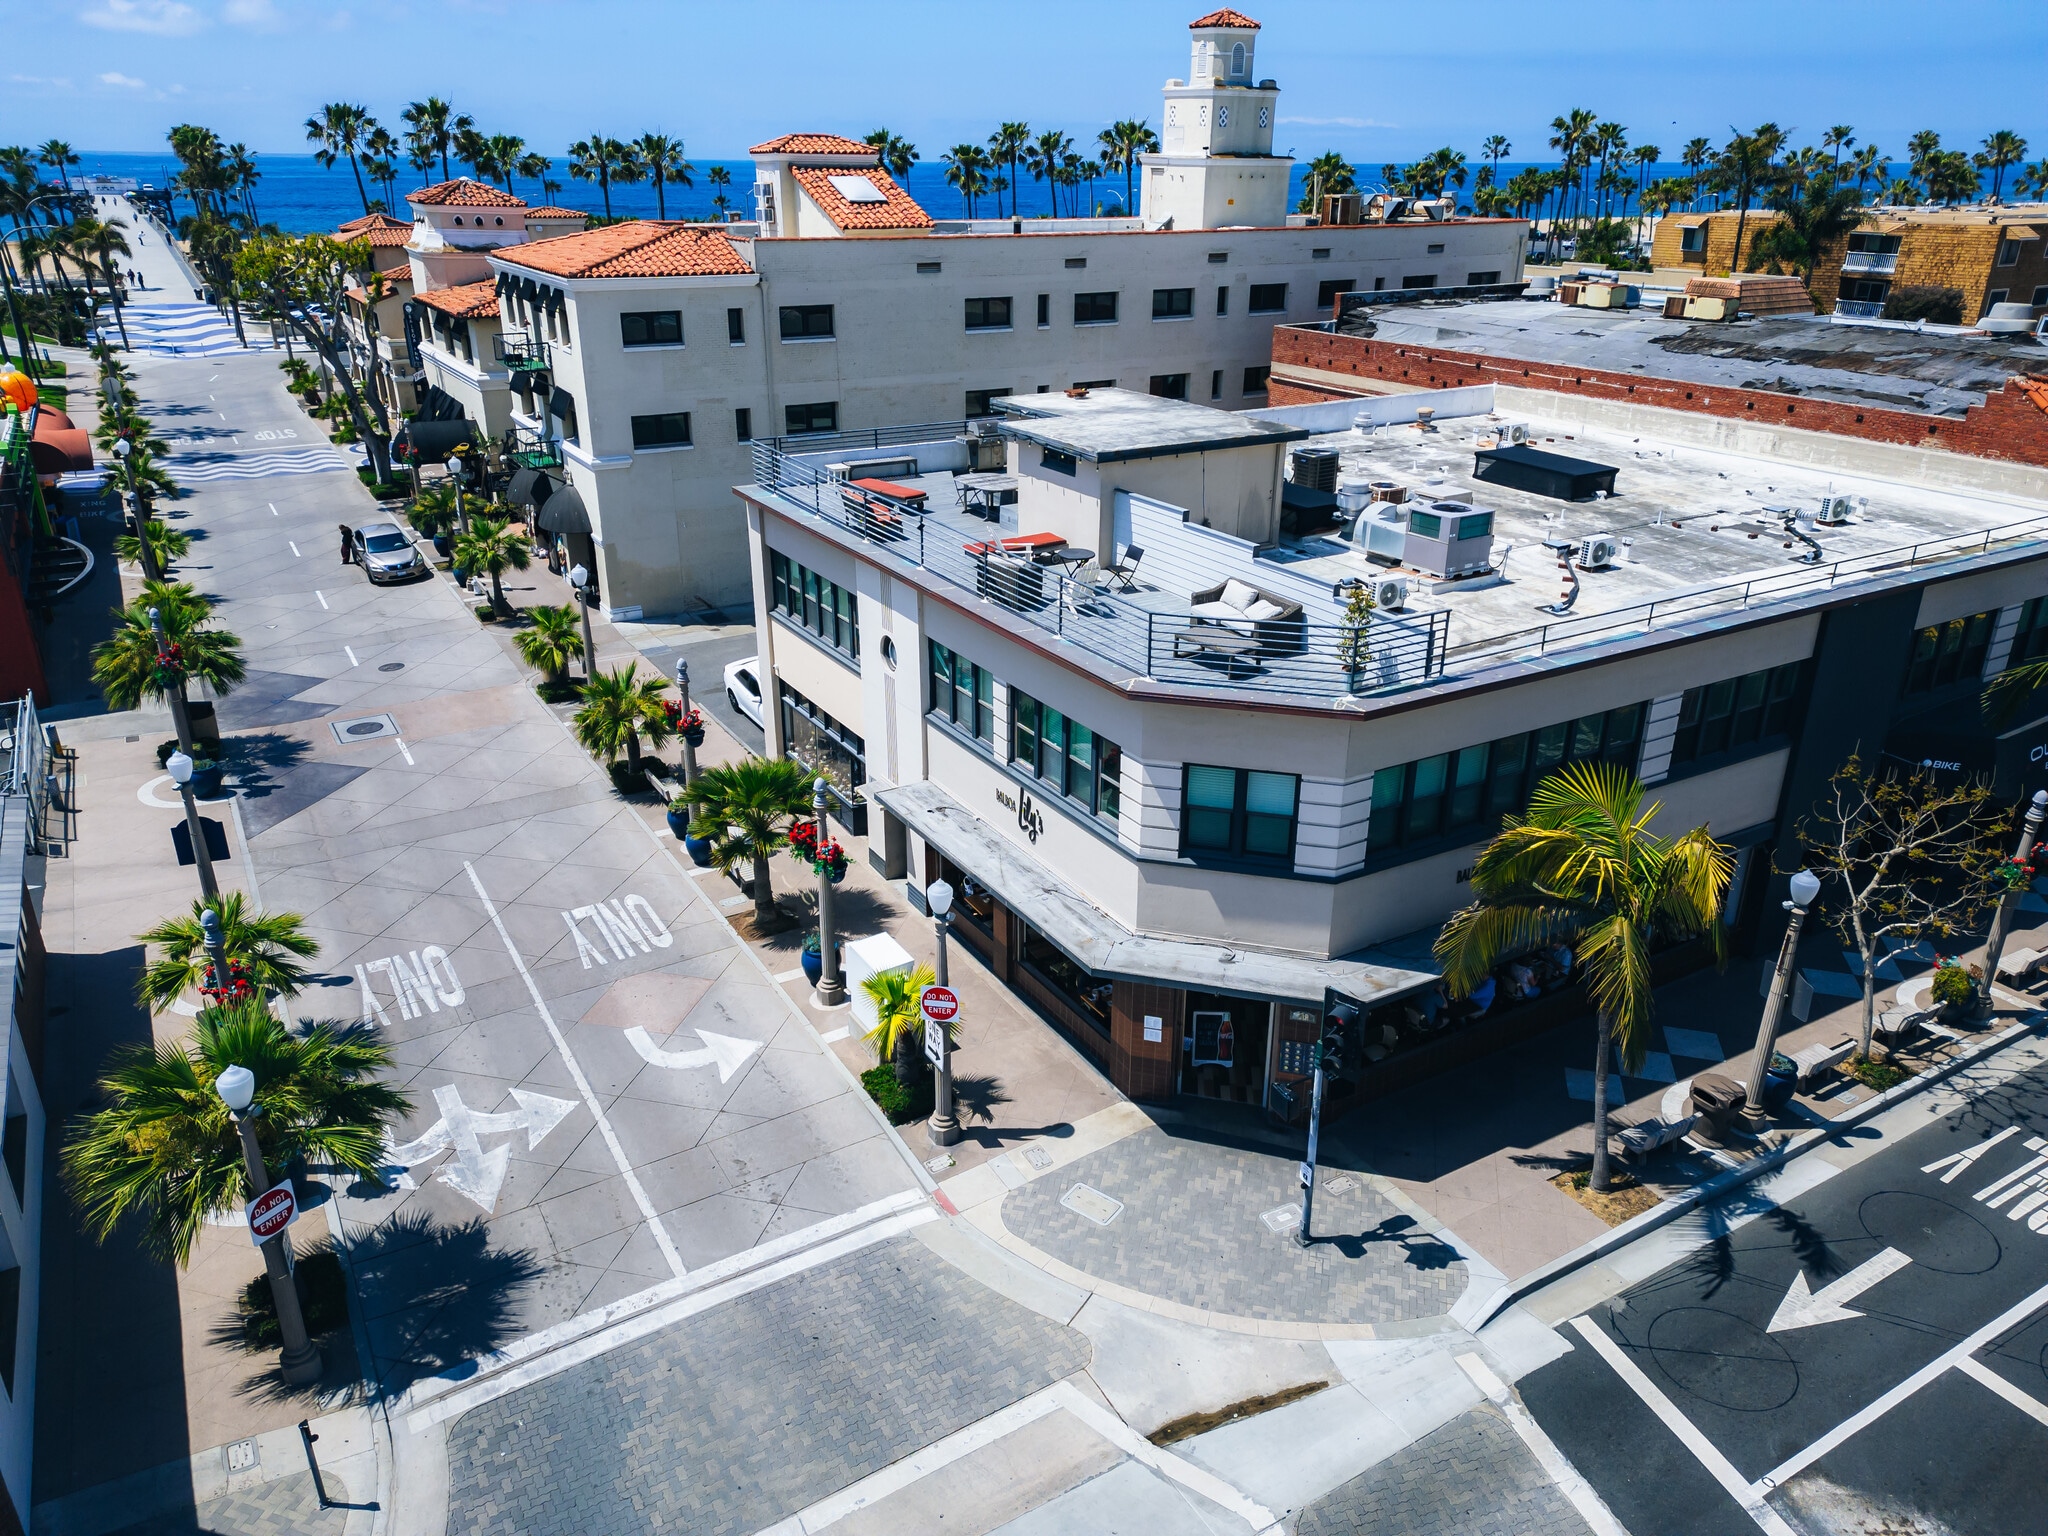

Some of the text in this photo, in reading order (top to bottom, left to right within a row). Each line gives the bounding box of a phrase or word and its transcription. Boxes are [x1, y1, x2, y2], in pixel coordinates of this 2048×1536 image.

[254, 428, 298, 441] STOP
[1933, 760, 1962, 771] BIKE
[996, 786, 1044, 845] BALBOA Lily's
[561, 893, 674, 970] ONLY
[355, 945, 466, 1030] ONLY
[928, 1006, 952, 1015] ENTER
[928, 1020, 940, 1037] ONE
[928, 1033, 941, 1049] WAY
[254, 1192, 286, 1217] DO NOT
[260, 1210, 288, 1232] ENTER
